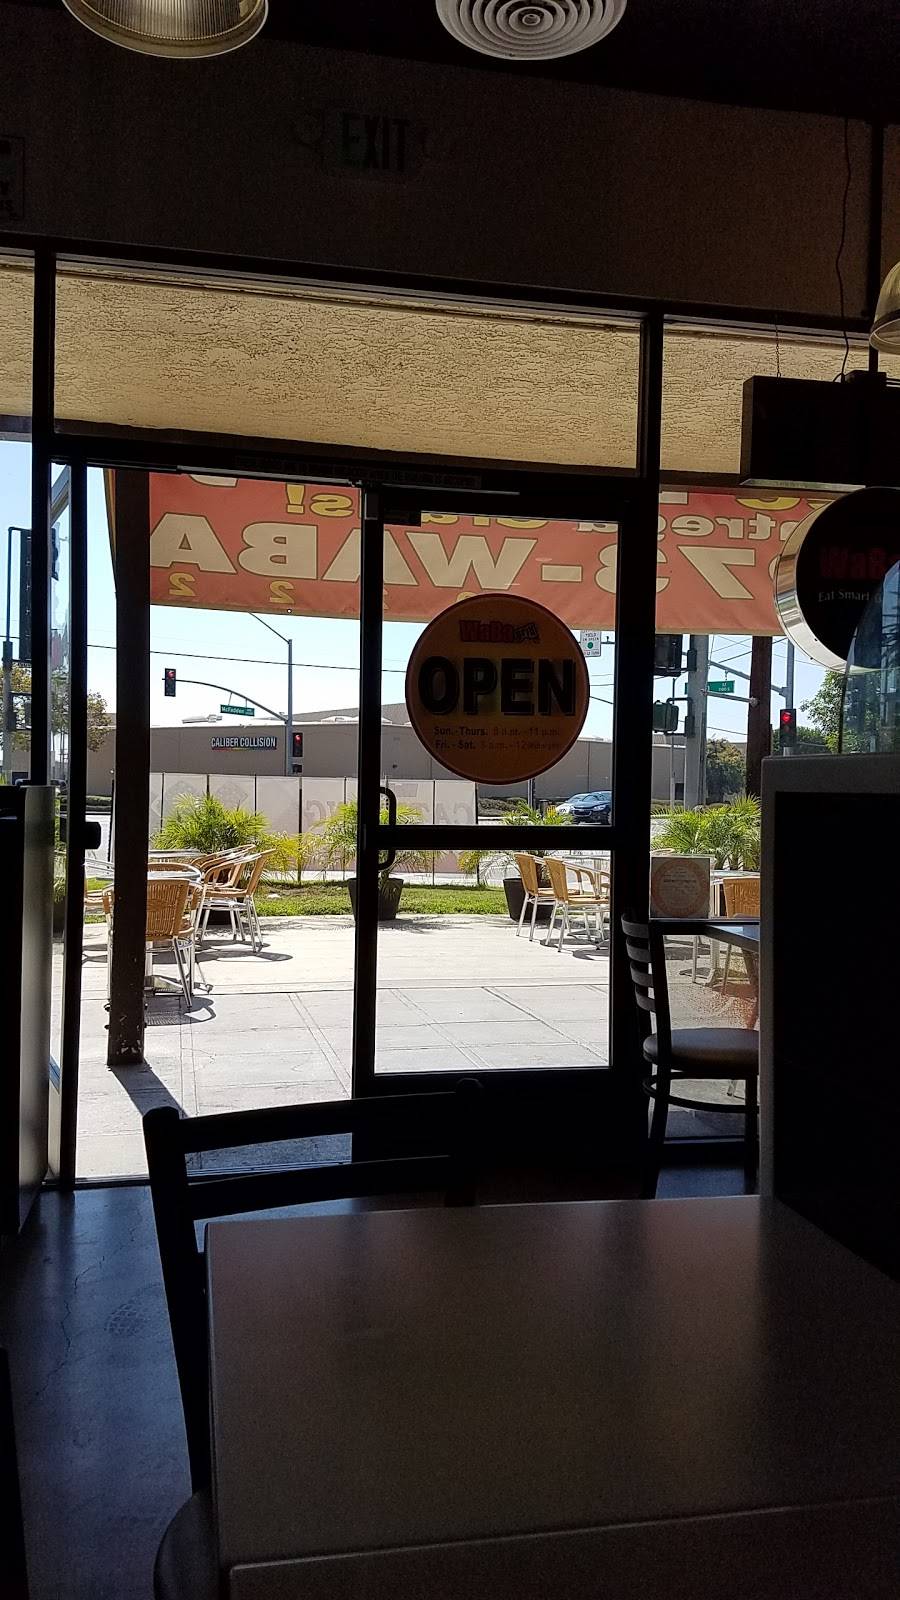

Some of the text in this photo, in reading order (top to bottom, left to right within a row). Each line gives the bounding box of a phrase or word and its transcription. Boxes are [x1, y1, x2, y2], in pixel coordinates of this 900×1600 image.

[341, 114, 410, 170] EXIT
[460, 620, 512, 643] WaBa
[418, 656, 577, 717] OPEN
[211, 737, 276, 747] CALIBER COLLISION
